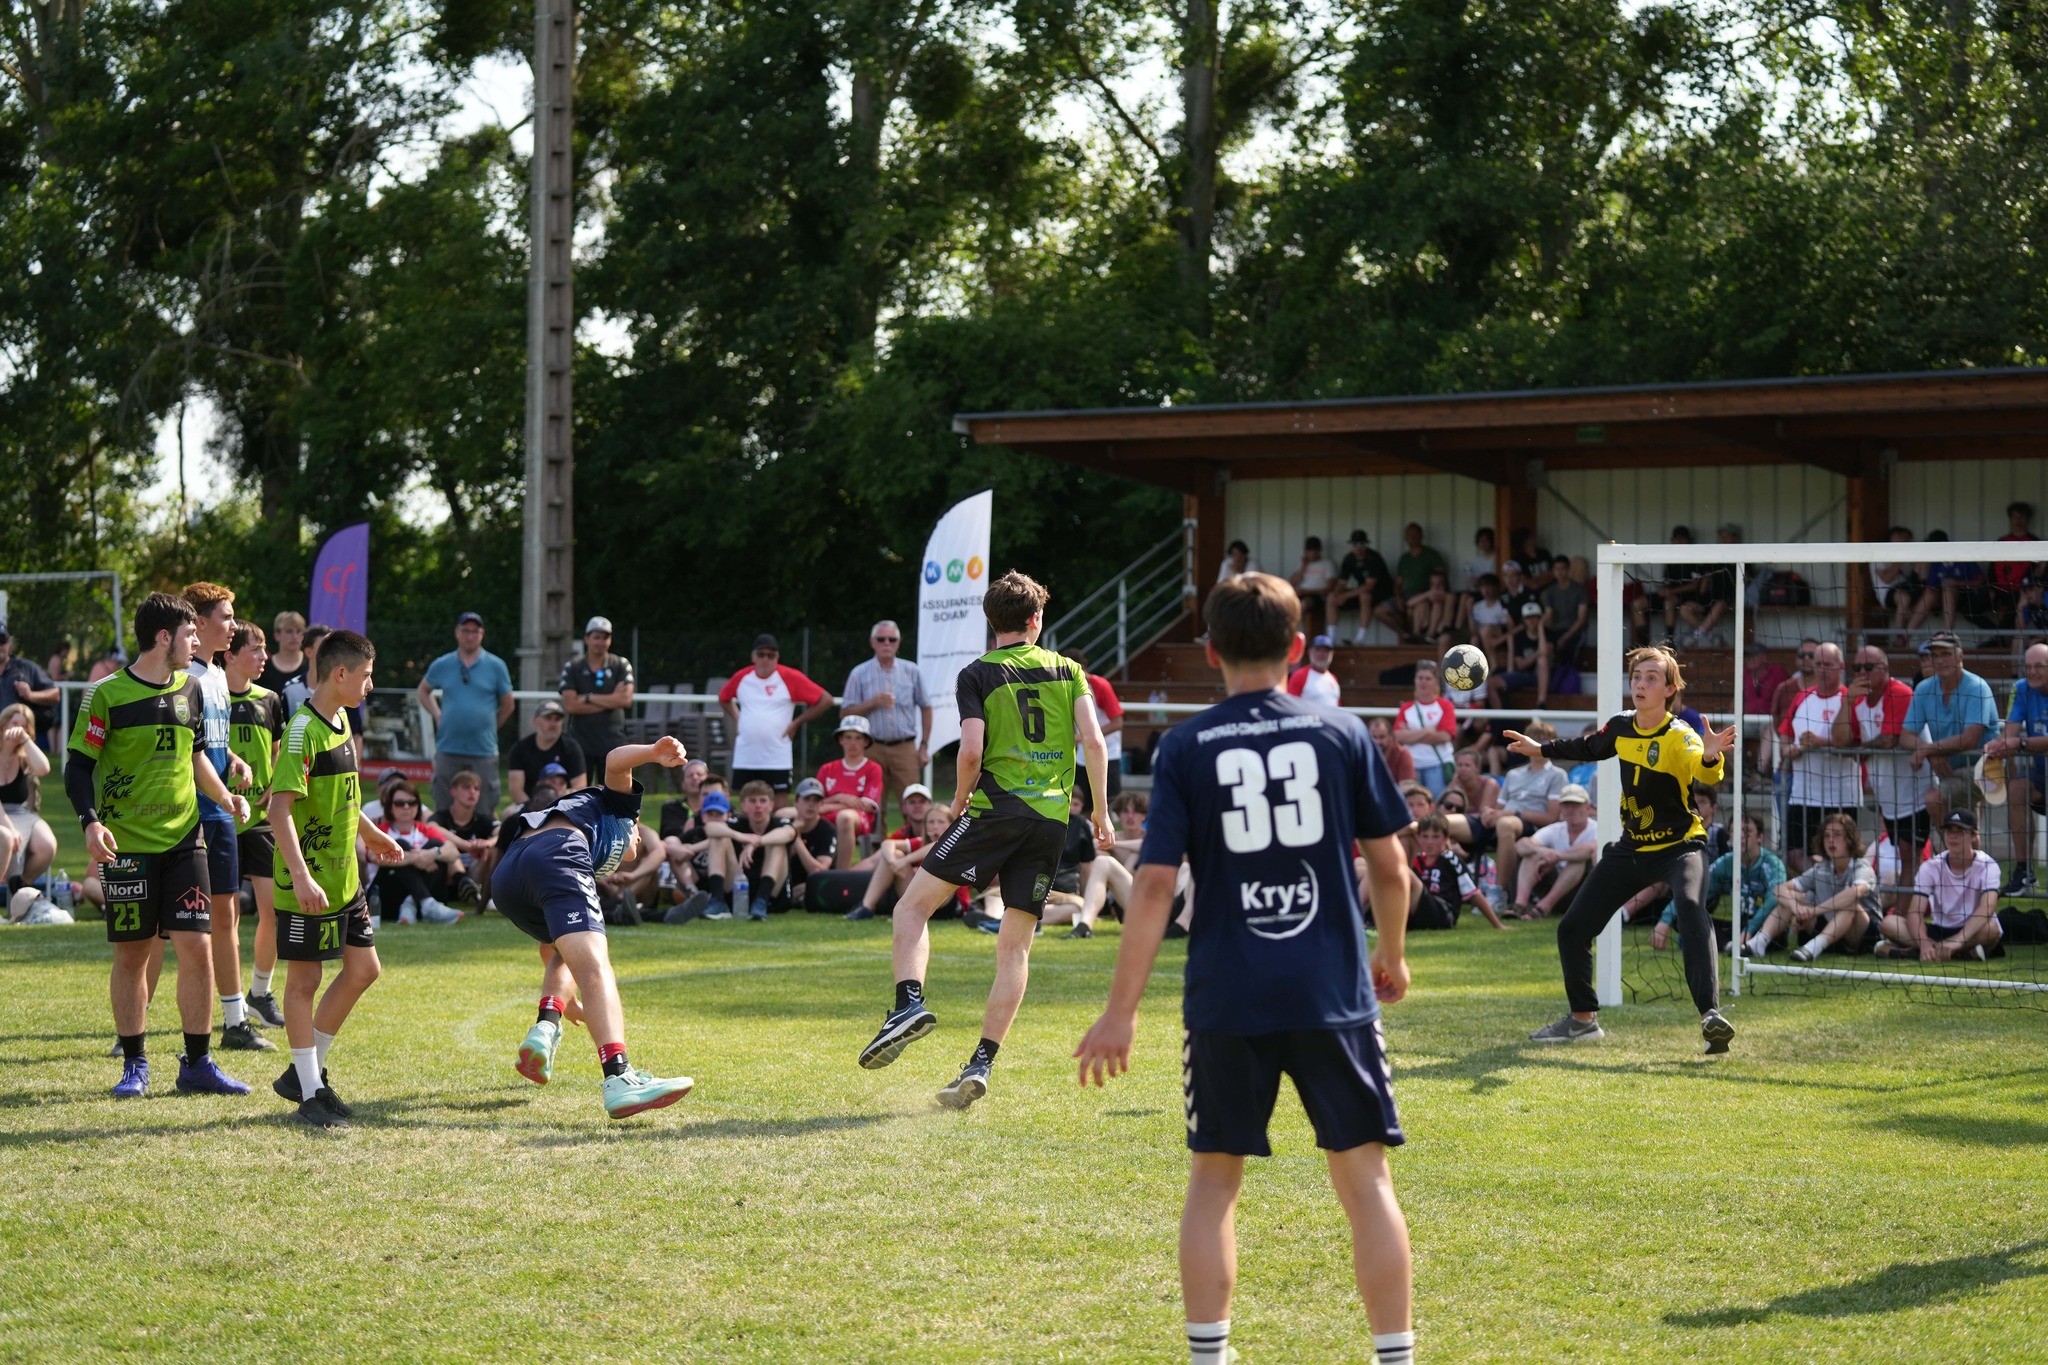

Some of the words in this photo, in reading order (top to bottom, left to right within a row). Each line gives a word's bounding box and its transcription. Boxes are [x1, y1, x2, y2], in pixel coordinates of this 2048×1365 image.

[1016, 688, 1046, 743] 6
[156, 728, 176, 751] 23
[238, 726, 252, 743] 10
[345, 775, 356, 801] 21
[1633, 764, 1641, 786] 1
[1215, 741, 1325, 854] 33
[108, 882, 144, 896] Nord
[961, 872, 977, 883] SELECT
[1240, 881, 1312, 915] Krys
[113, 902, 141, 931] 23
[319, 920, 340, 950] 21
